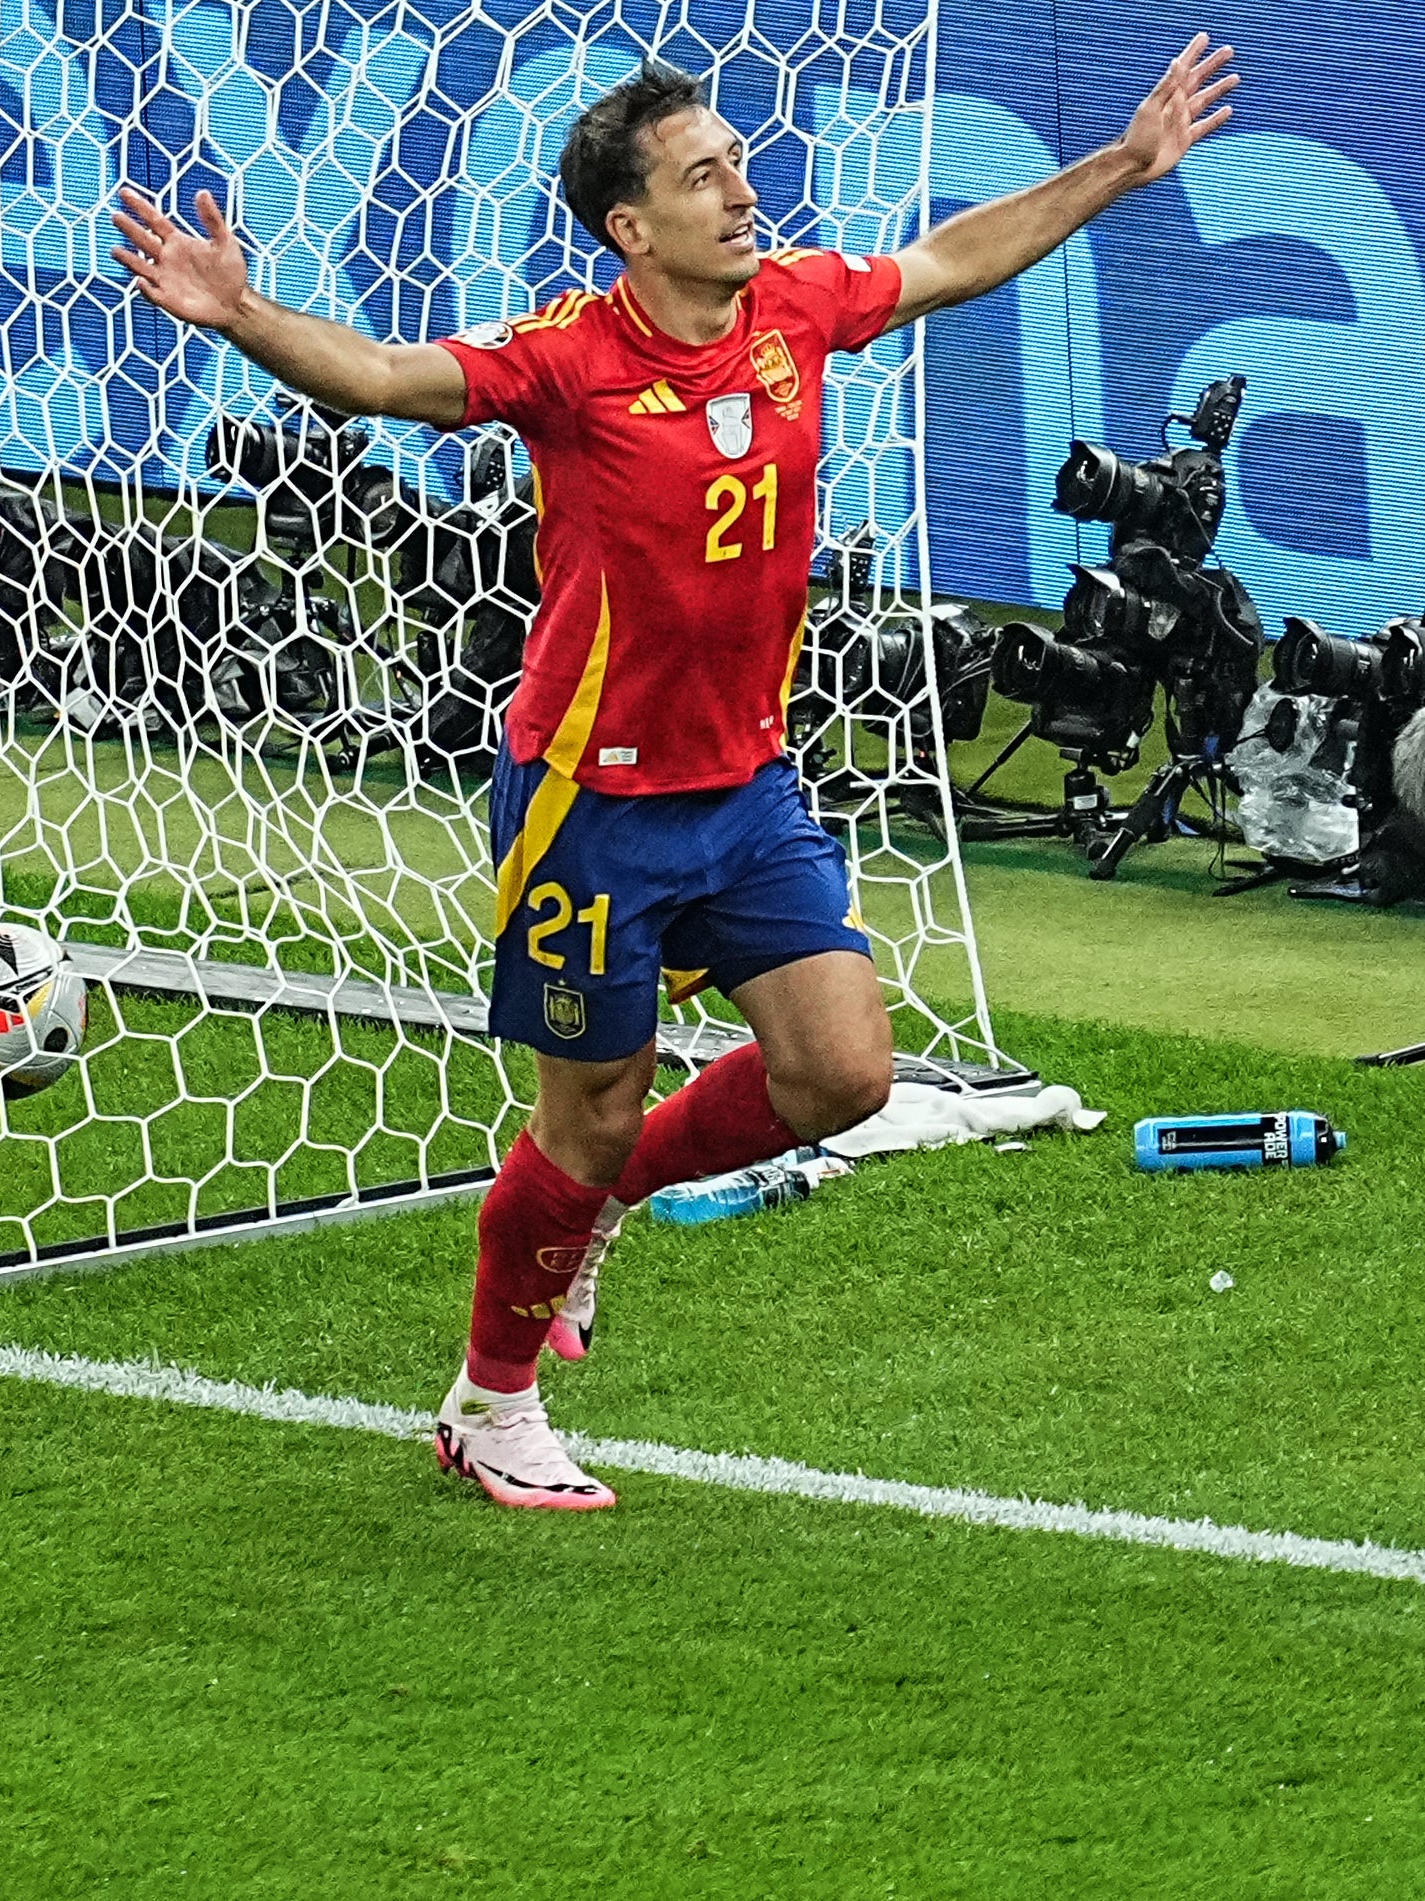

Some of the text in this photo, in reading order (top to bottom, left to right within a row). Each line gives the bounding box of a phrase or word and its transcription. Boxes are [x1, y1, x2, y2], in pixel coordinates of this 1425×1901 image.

[705, 463, 779, 563] 21
[526, 881, 611, 976] 21
[1264, 1132, 1276, 1160] ADE
[1274, 1112, 1288, 1159] POWER
